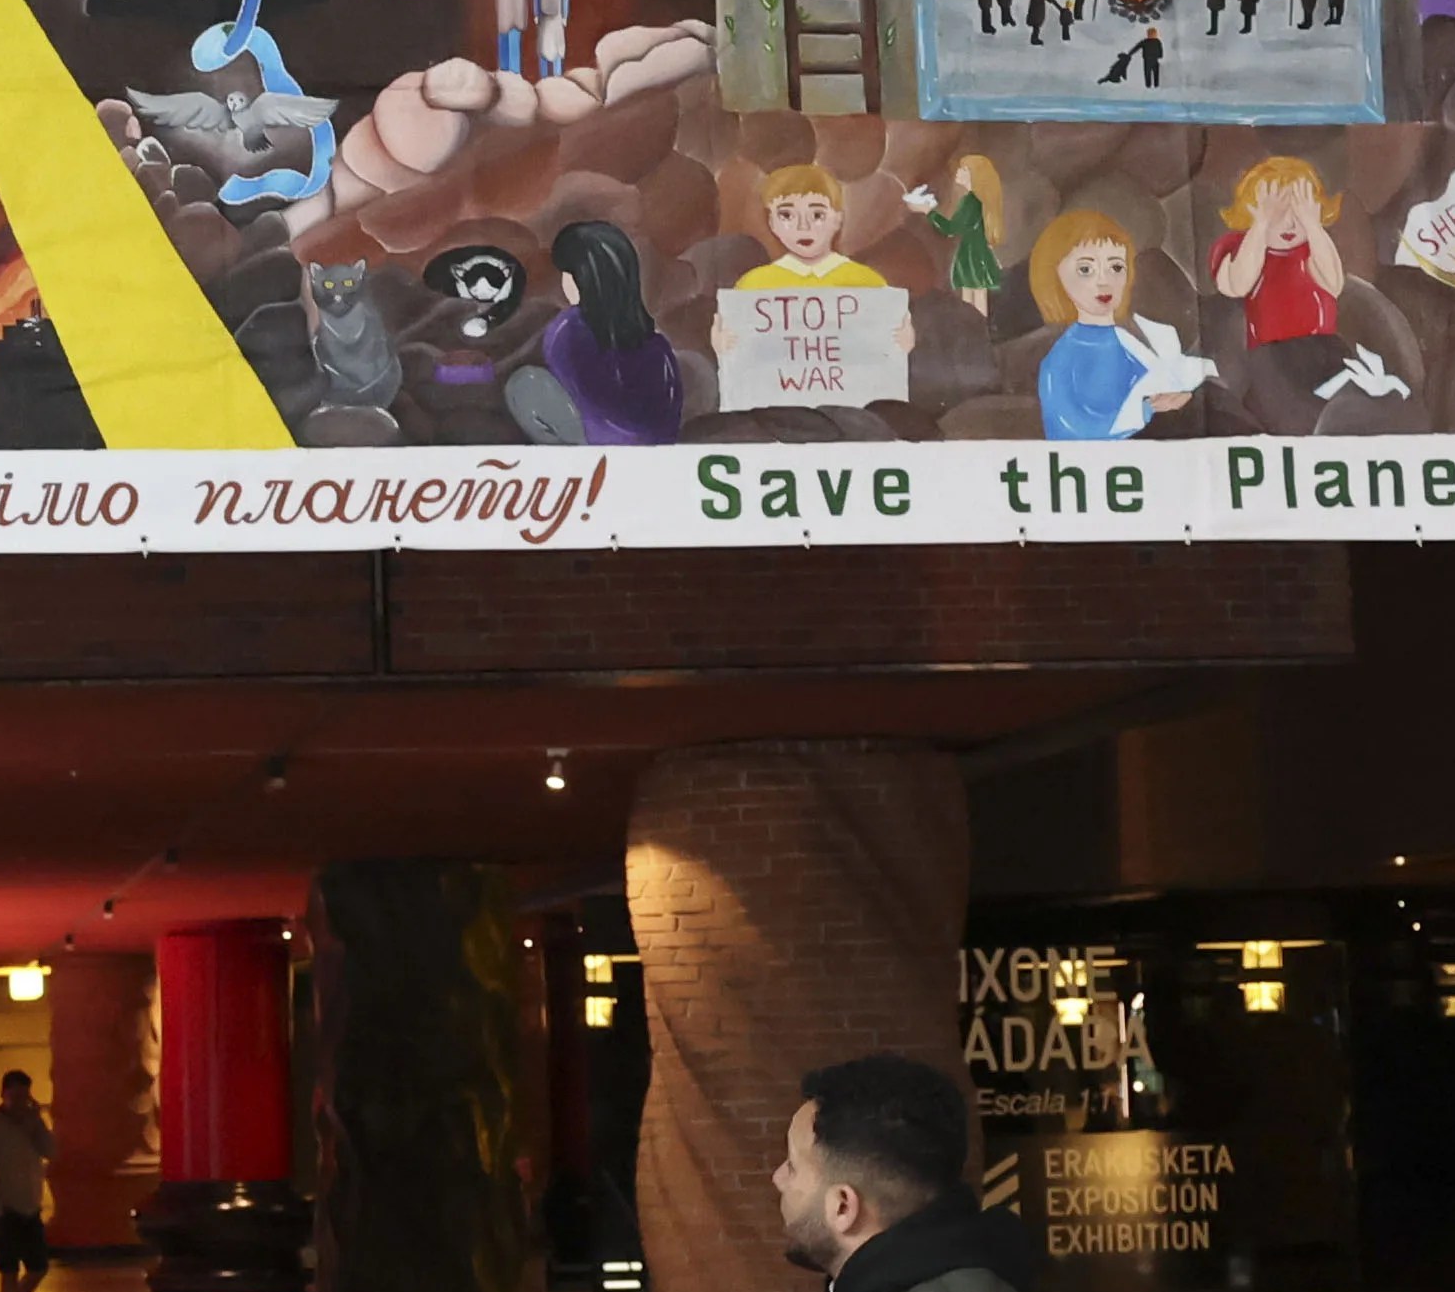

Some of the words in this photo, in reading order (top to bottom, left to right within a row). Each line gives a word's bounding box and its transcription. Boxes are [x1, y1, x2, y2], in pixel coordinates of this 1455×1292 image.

[753, 295, 860, 333] STOP
[784, 334, 842, 364] THE
[778, 363, 845, 393] WAR
[192, 455, 608, 544] планету!
[697, 454, 911, 520] Save
[999, 453, 1145, 513] the
[958, 946, 1117, 1003] IXONE
[963, 1006, 1155, 1073] ÁDABA
[976, 1088, 1066, 1116] Escala
[1044, 1144, 1234, 1179] ERAKUSKETA
[1047, 1177, 1218, 1216] EXPOSICIÓN
[1048, 1220, 1210, 1254] EXHIBITION
